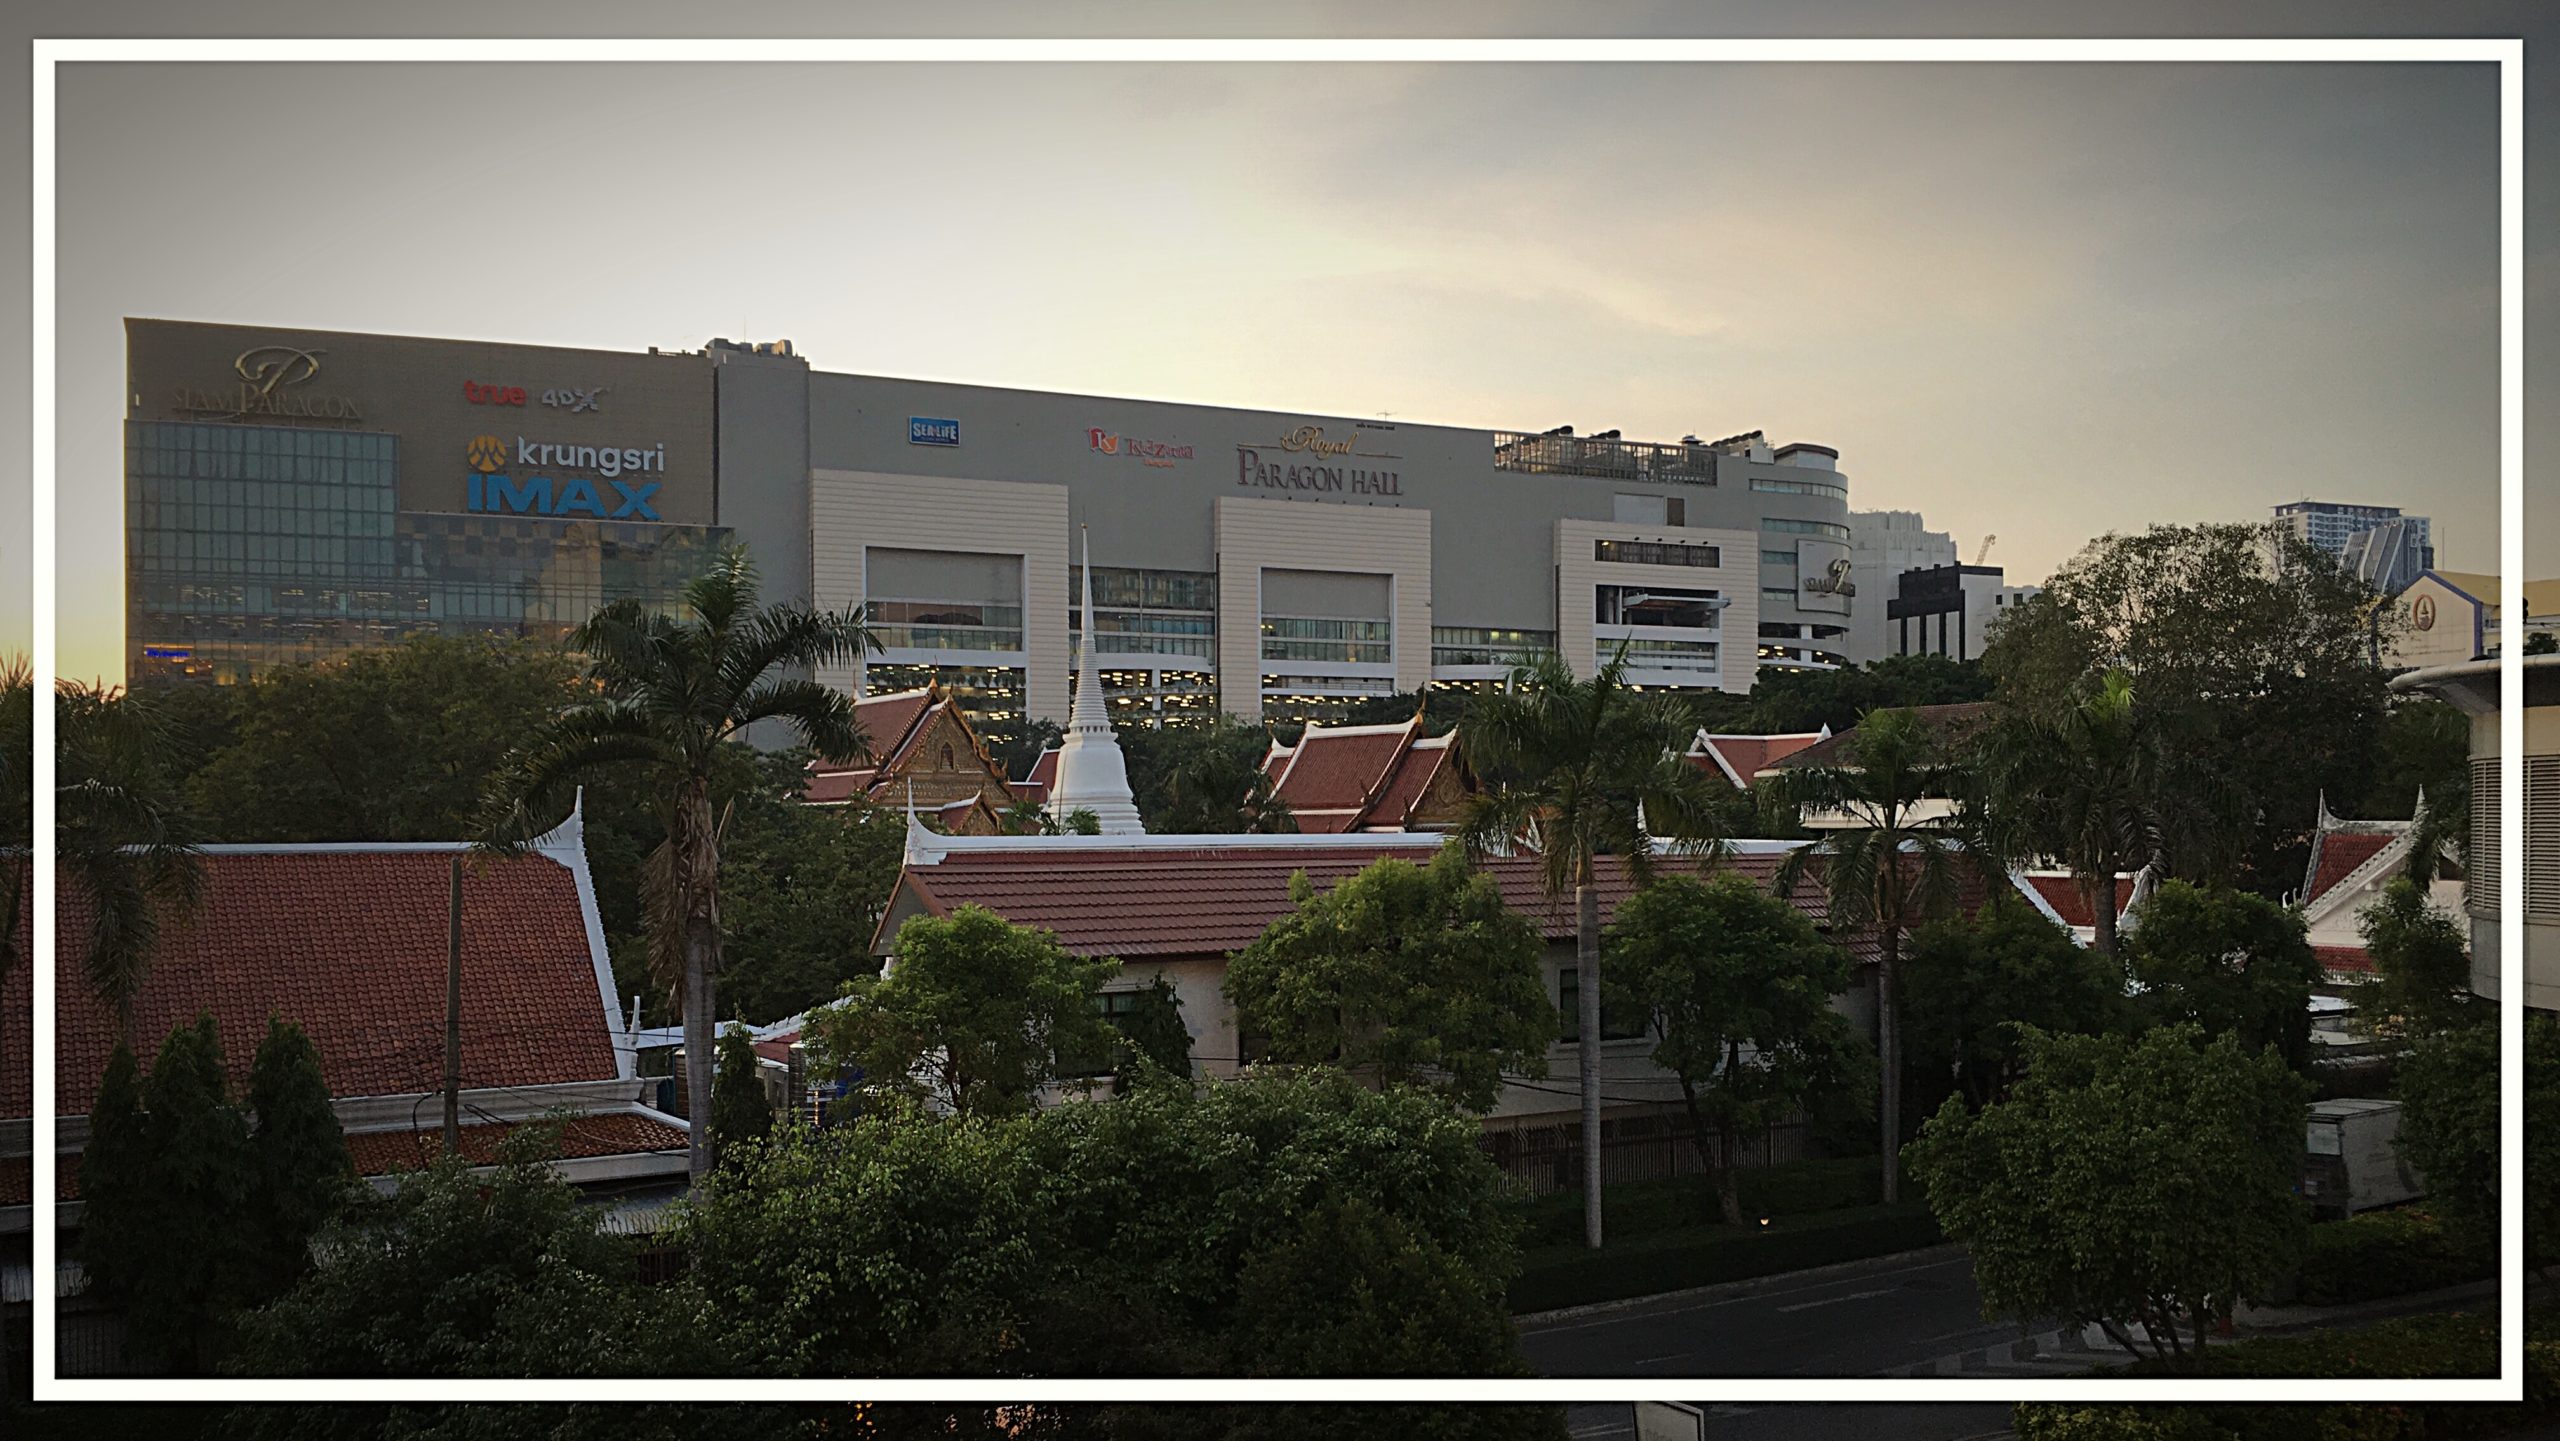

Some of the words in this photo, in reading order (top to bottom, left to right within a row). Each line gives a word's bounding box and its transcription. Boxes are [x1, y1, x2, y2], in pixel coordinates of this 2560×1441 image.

[463, 380, 527, 405] true
[912, 422, 934, 437] SEA
[1281, 425, 1359, 461] Royal
[517, 436, 664, 477] krungsri
[1237, 448, 1344, 492] PARAGON
[1351, 468, 1403, 496] HALL
[467, 473, 663, 519] IMAX
